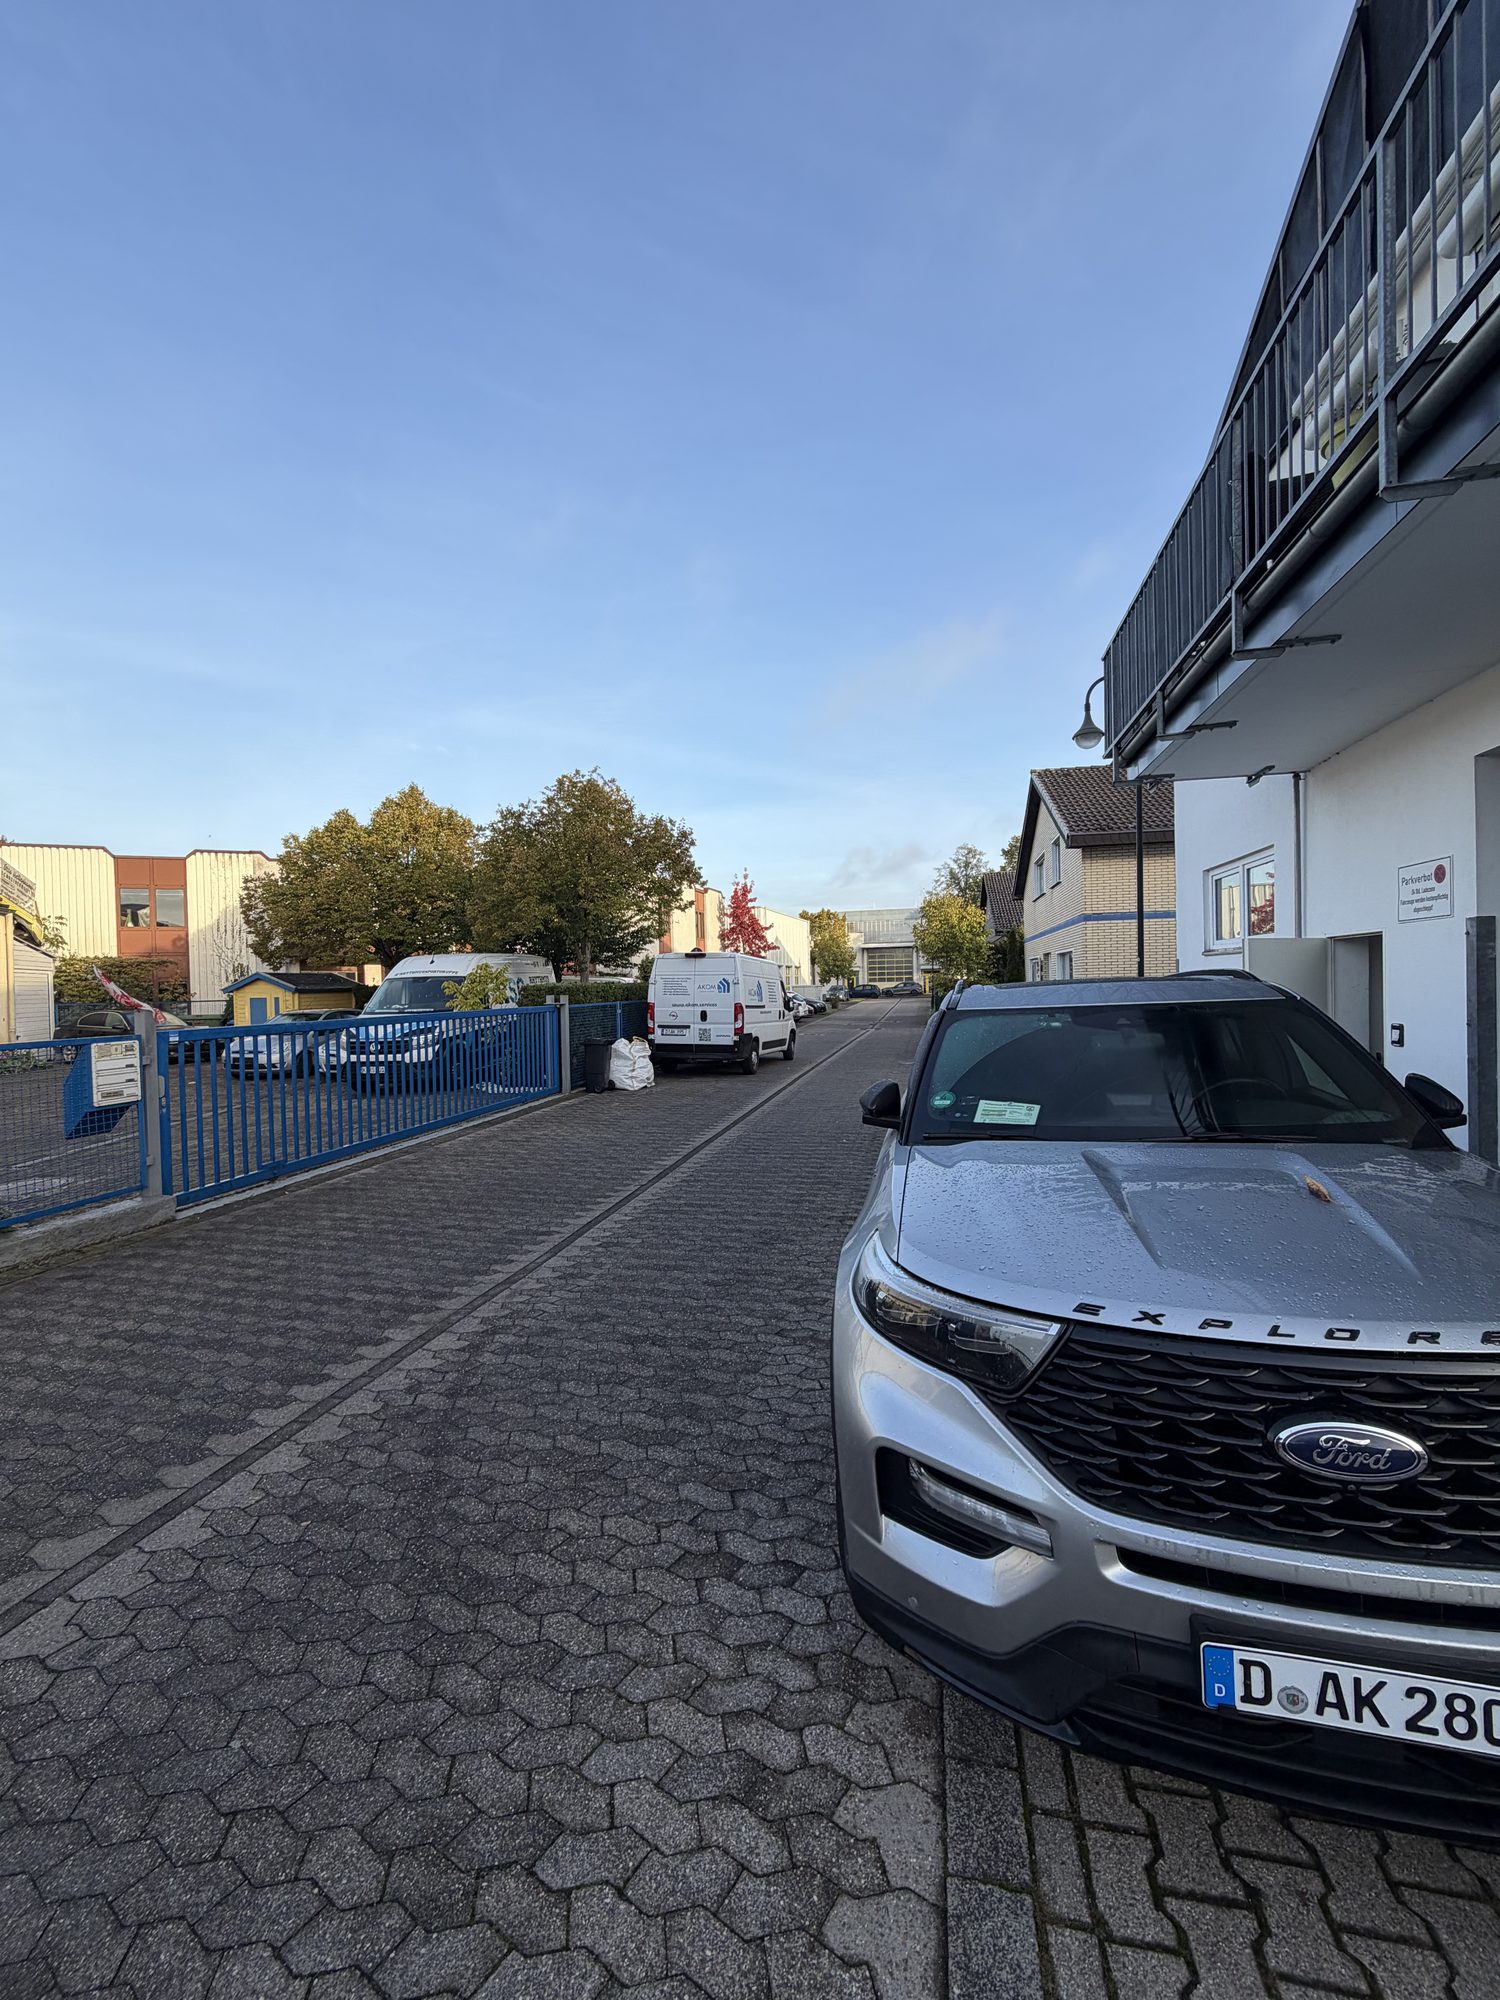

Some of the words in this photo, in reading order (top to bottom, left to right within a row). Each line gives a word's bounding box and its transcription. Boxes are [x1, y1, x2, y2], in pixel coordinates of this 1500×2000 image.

[1402, 872, 1432, 886] Parkverbot
[1312, 1434, 1392, 1470] Ford
[1214, 1683, 1226, 1697] D
[1238, 1658, 1272, 1706] D
[1315, 1671, 1390, 1728] AK
